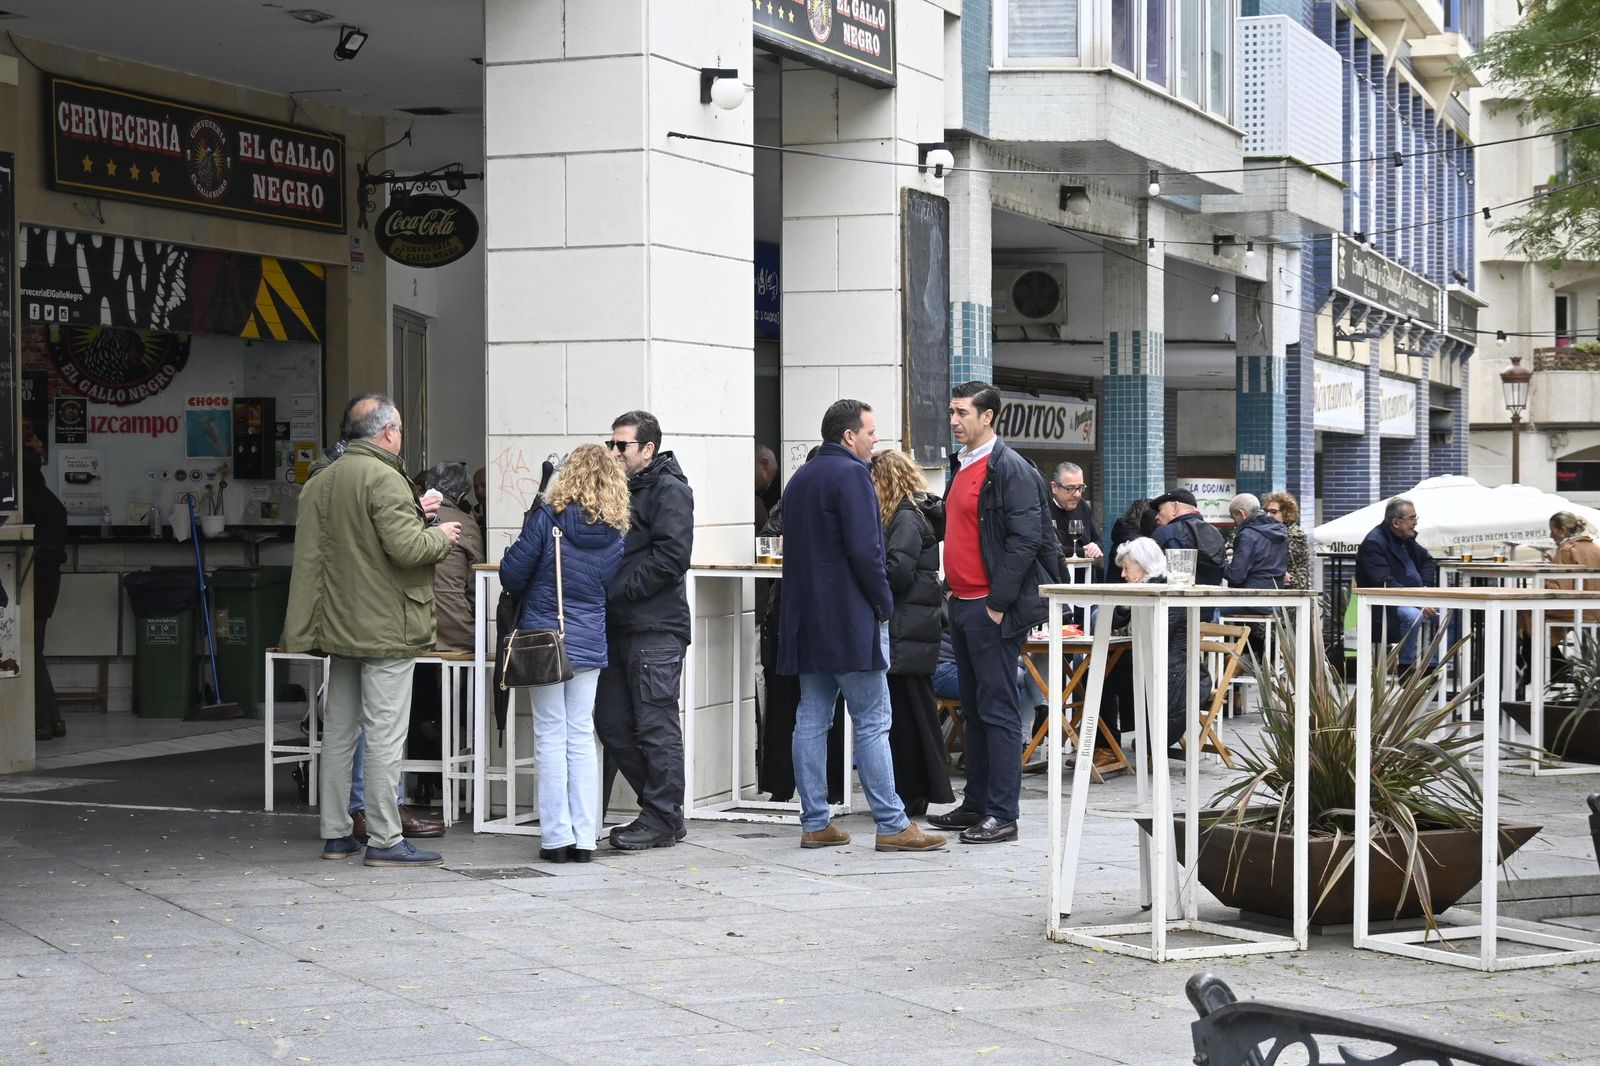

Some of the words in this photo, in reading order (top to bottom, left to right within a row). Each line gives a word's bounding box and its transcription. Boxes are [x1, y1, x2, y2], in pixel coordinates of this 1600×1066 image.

[851, 0, 886, 29] GALLO
[842, 22, 881, 54] NEGRO
[58, 101, 182, 153] CERVECERÍA
[239, 131, 266, 161] EL
[269, 138, 335, 173] GALLO
[252, 173, 325, 209] NEGRO
[384, 208, 459, 237] Coca-Cola
[60, 362, 79, 383] EL
[78, 380, 127, 402] GALLO
[129, 364, 177, 401] NEGRO
[188, 396, 229, 407] CHOCO
[88, 415, 180, 438] uzcampo
[996, 403, 1066, 440] ADITOS
